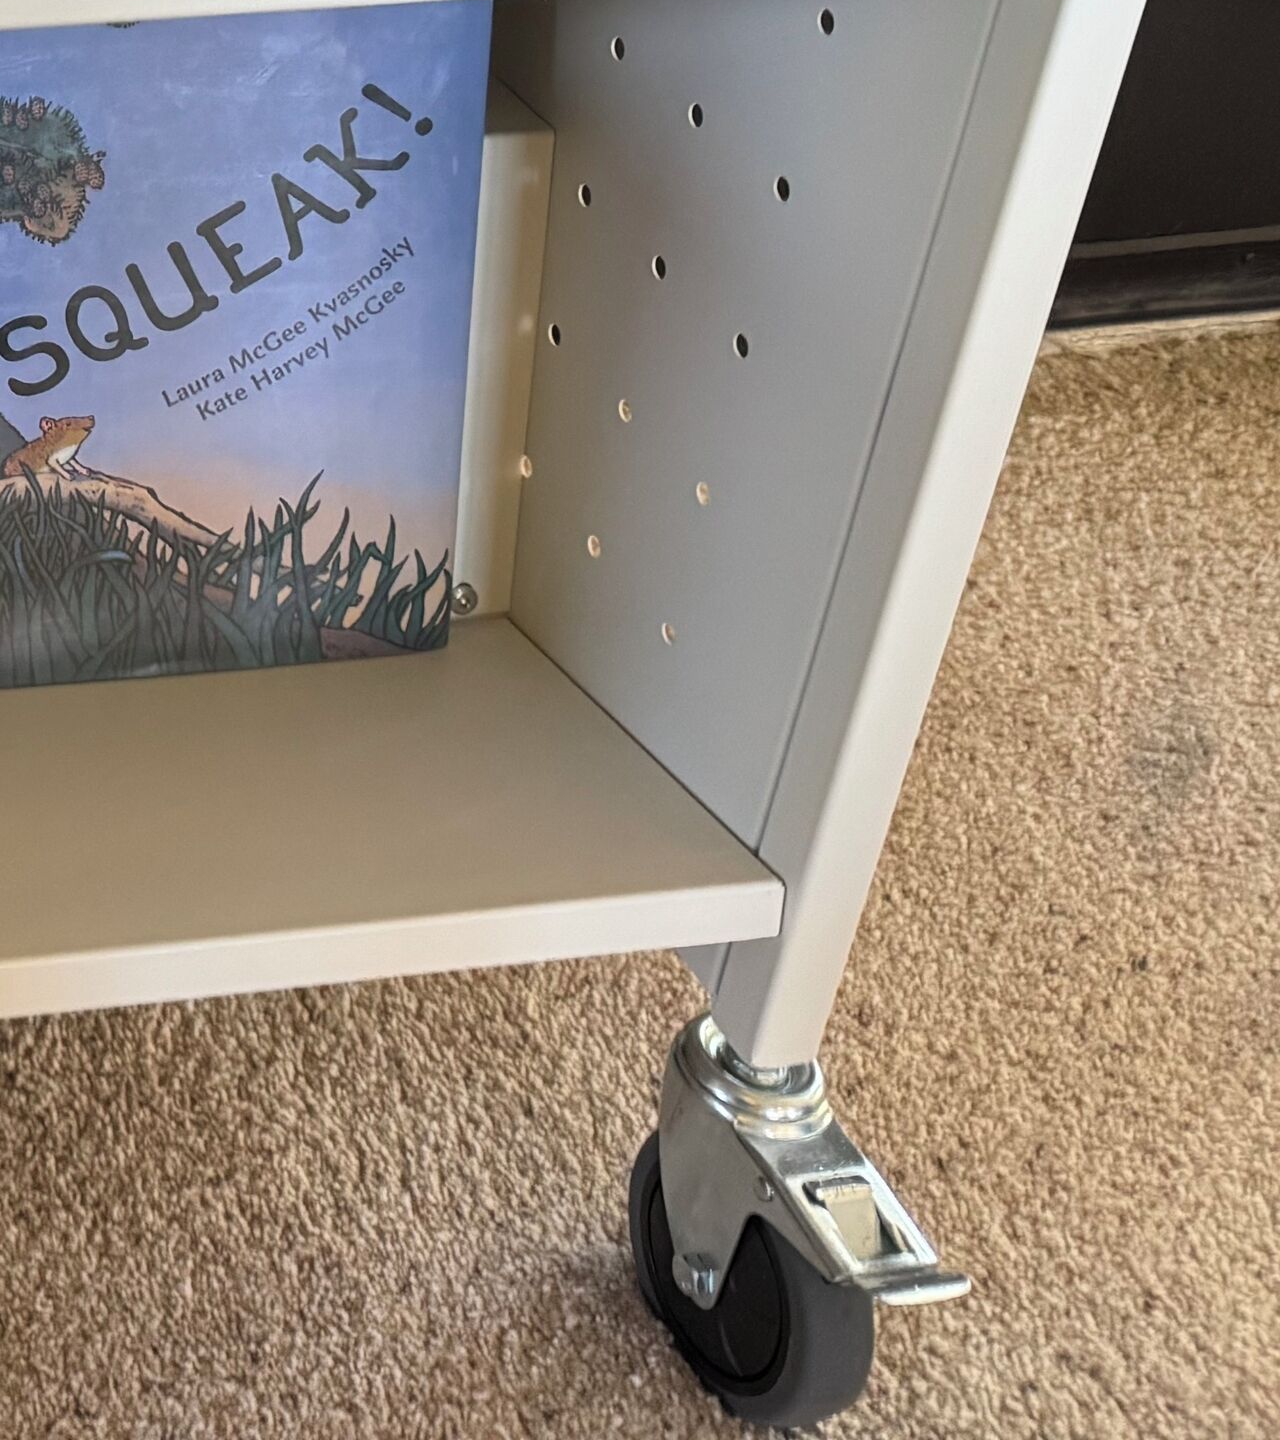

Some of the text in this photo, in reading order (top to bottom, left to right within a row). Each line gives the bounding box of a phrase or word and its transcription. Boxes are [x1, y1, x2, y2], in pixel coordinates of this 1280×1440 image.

[160, 234, 417, 409] Laura McGee Kvasnosky
[194, 278, 408, 423] Kate Harvey McGee
